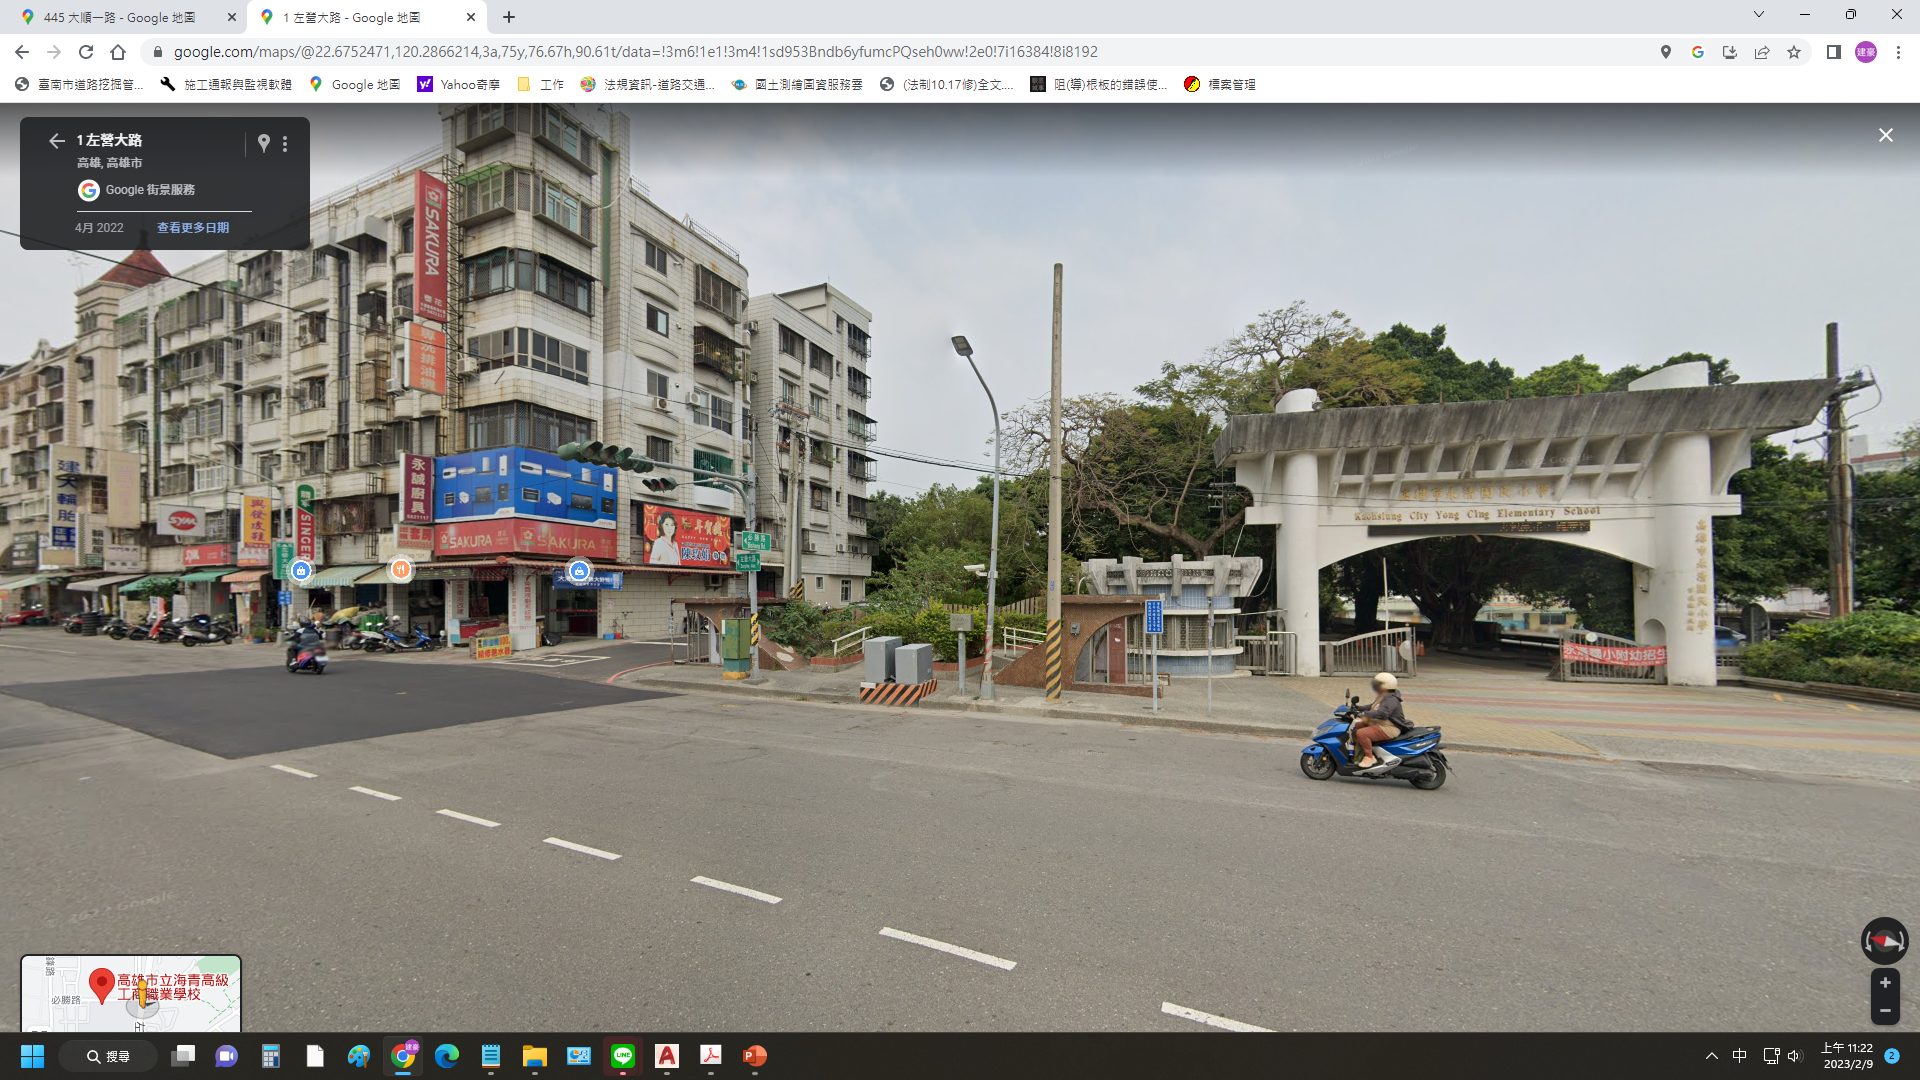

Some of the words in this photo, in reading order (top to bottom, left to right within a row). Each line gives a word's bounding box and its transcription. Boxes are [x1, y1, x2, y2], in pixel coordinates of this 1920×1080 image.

[44, 13, 64, 23] 445
[68, 12, 116, 23] 大順一路
[127, 12, 168, 25] Google
[172, 12, 195, 23] 地圖
[284, 12, 289, 22] 1
[293, 12, 341, 23] 左營大路
[353, 12, 393, 25] Google
[397, 12, 420, 23] 地圖
[1857, 48, 1875, 57] 建豪
[184, 78, 292, 91] 施工通報與監視軟體
[332, 79, 373, 93] Google
[377, 78, 400, 90] 地圖
[441, 78, 500, 91] Yahoo奇摩
[540, 79, 564, 91] 工作
[756, 78, 863, 91] 國土測繪圖資服務雲
[1209, 78, 1256, 91] 標案管理
[77, 134, 83, 146] 1
[86, 133, 142, 147] 左營大路
[77, 157, 104, 169] 高雄,
[107, 157, 142, 169] 高雄市
[106, 184, 144, 197] Google
[147, 183, 195, 196] 街景服務
[75, 222, 93, 234] 4月
[97, 222, 123, 233] 2022
[157, 222, 229, 234] 查看更多日期
[425, 206, 440, 276] SAKURA
[411, 458, 426, 514] 永誠廚具
[1401, 484, 1551, 502] 高雄市永清國民小學
[168, 515, 198, 526] SYM
[1354, 511, 1402, 522] Kaohsiung
[1409, 511, 1429, 522] City
[1436, 510, 1460, 521] Yong
[1467, 509, 1490, 520] Cing
[1497, 507, 1556, 519] Elementary
[1564, 506, 1601, 516] School
[449, 534, 492, 549] SAKURA
[537, 535, 596, 551] SAKURA
[747, 533, 766, 543] 必勝路
[681, 547, 711, 562] 陳玫娟
[117, 973, 229, 988] 高雄市立海青高級
[51, 995, 81, 1006] 必勝路
[1821, 1042, 1845, 1054] 上午
[1848, 1043, 1873, 1053] 11:22
[105, 1051, 131, 1064] 搜尋
[745, 1051, 753, 1060] P
[1733, 1048, 1747, 1063] 中
[1889, 1052, 1894, 1060] 2
[1824, 1059, 1873, 1070] 2023/2/9
